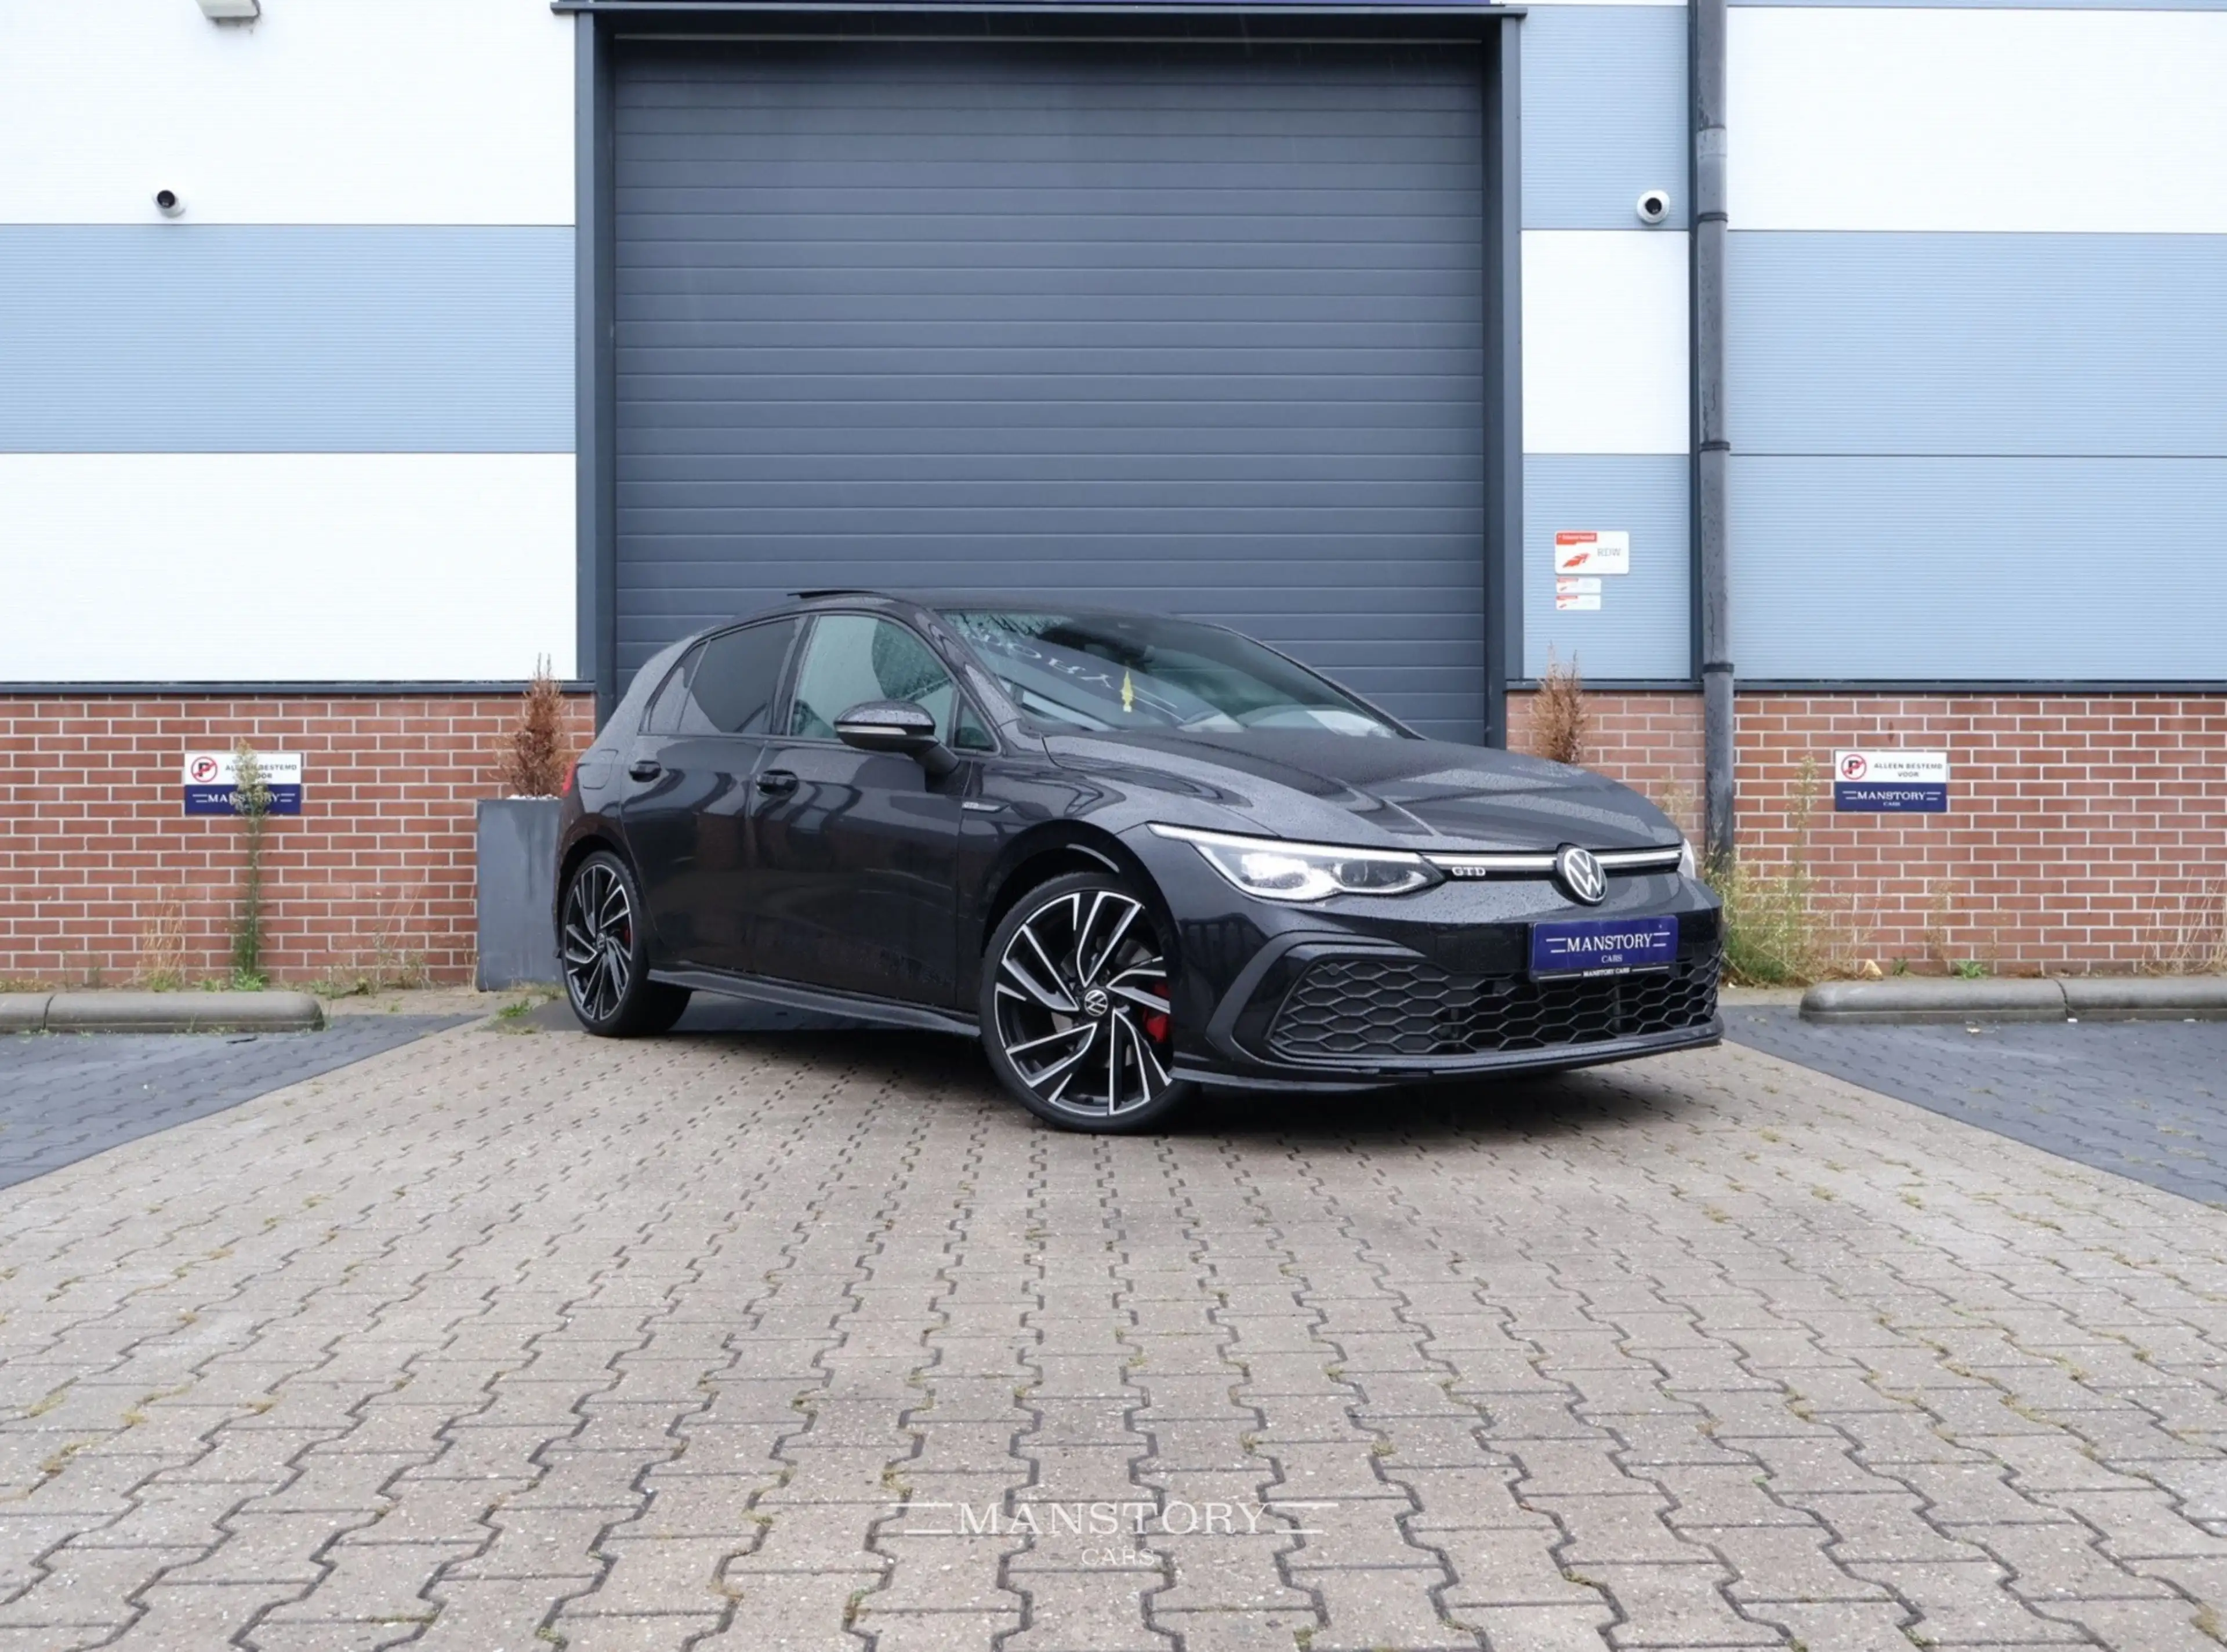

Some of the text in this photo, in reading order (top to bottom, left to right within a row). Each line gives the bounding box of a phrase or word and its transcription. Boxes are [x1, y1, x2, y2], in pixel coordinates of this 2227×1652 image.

[1597, 548, 1621, 557] RDW
[1856, 791, 1926, 801] MANSTORY
[1452, 866, 1486, 877] GTD
[1567, 932, 1653, 953] MANSTORY
